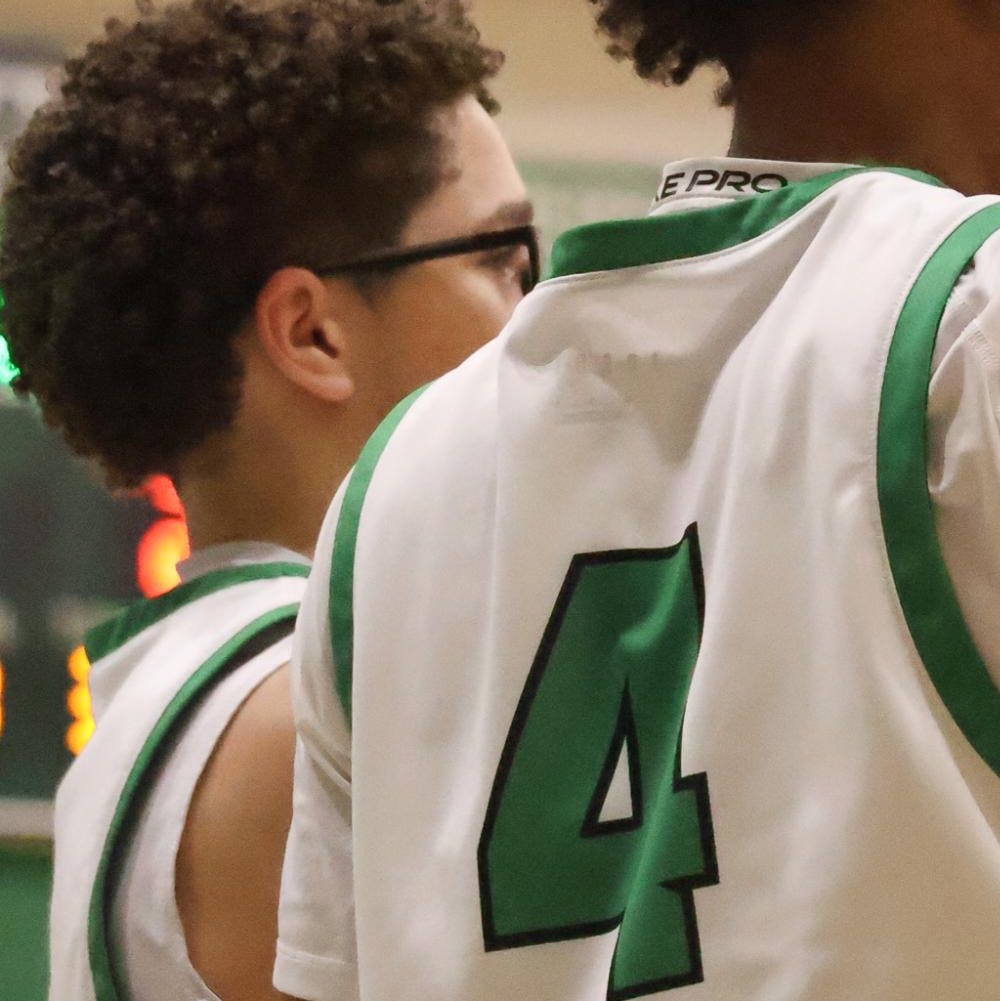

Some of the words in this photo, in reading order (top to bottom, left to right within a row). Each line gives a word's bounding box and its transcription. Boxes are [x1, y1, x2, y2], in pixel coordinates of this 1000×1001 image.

[656, 172, 685, 201] E
[685, 169, 788, 193] PRO
[478, 521, 719, 1001] 4
